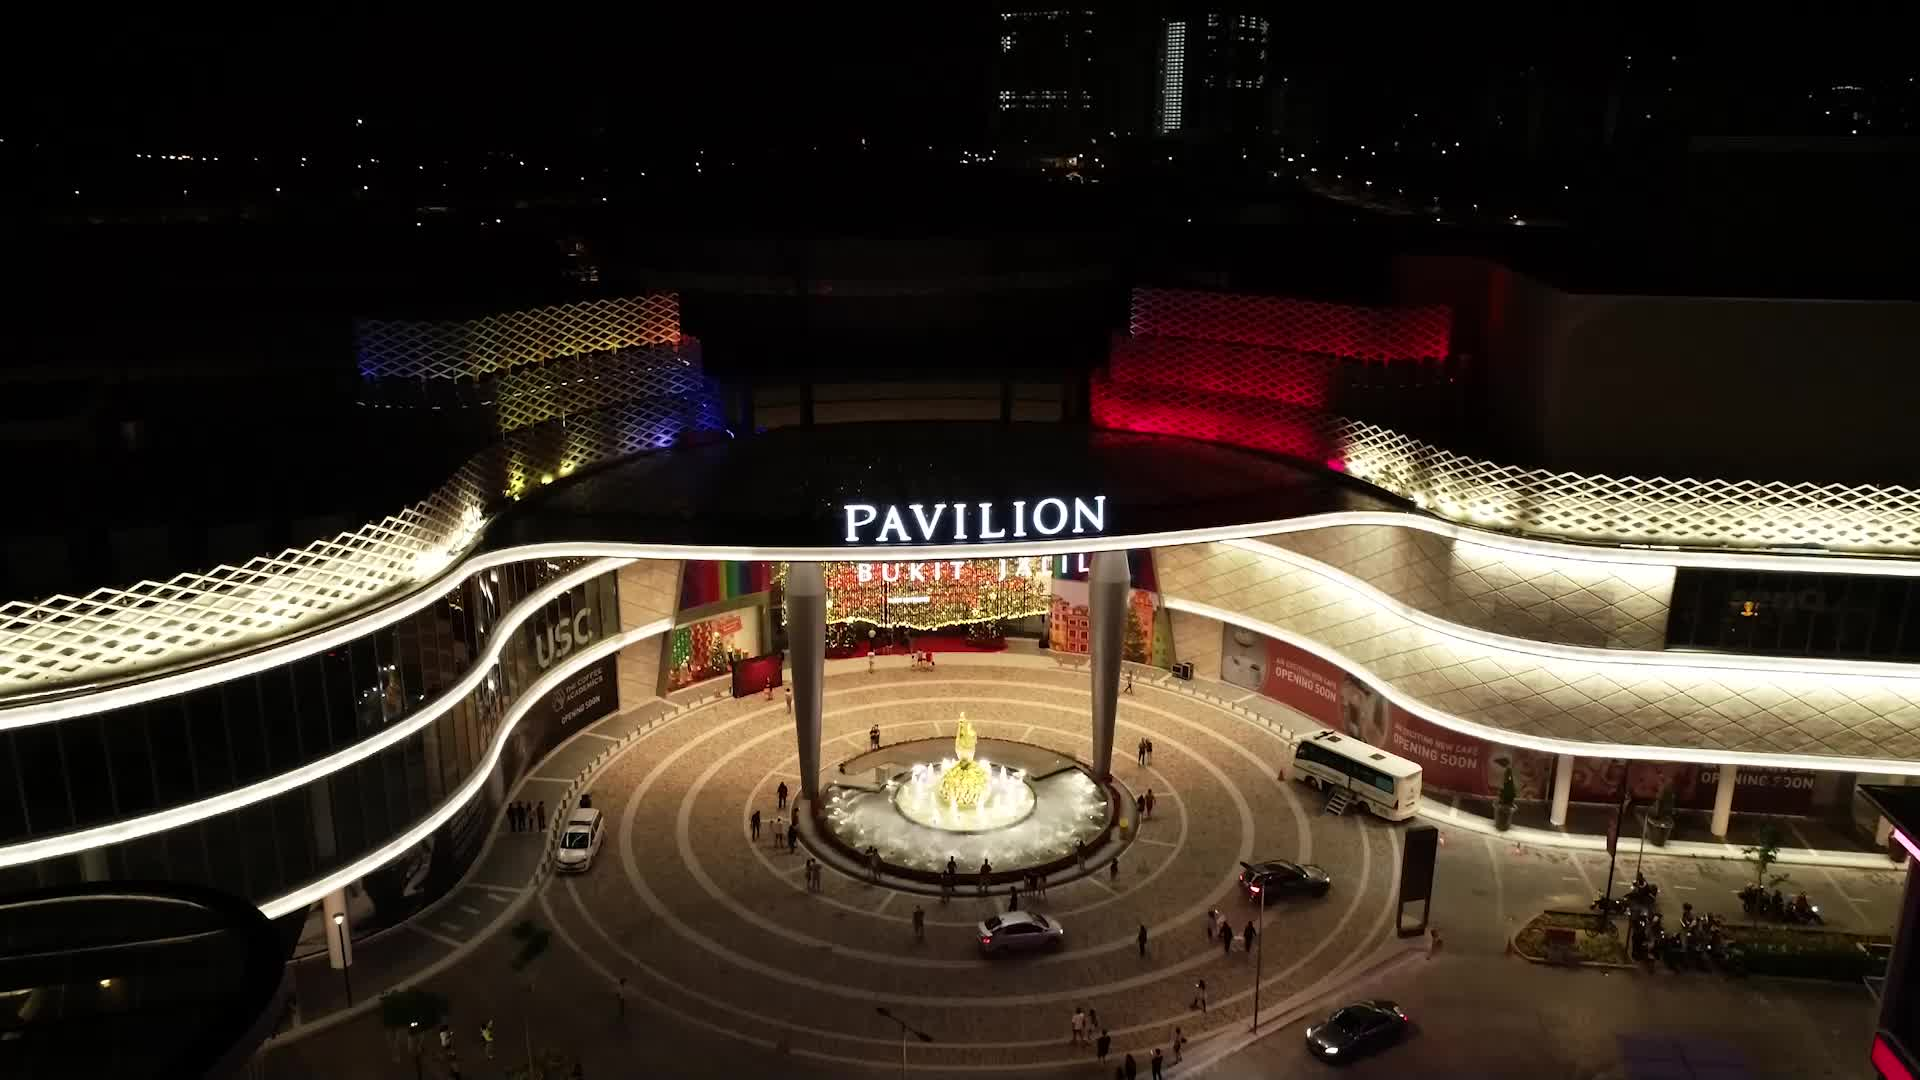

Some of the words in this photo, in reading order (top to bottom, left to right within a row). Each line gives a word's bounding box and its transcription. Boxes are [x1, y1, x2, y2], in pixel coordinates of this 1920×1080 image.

[843, 496, 1106, 541] PAVILION
[857, 560, 965, 584] BUKIT
[999, 553, 1090, 580] JALIL
[536, 608, 592, 669] USC
[1275, 666, 1314, 690] OPENING
[1314, 683, 1337, 703] SOON
[1393, 733, 1437, 761] OPENING
[1440, 753, 1477, 769] SOON
